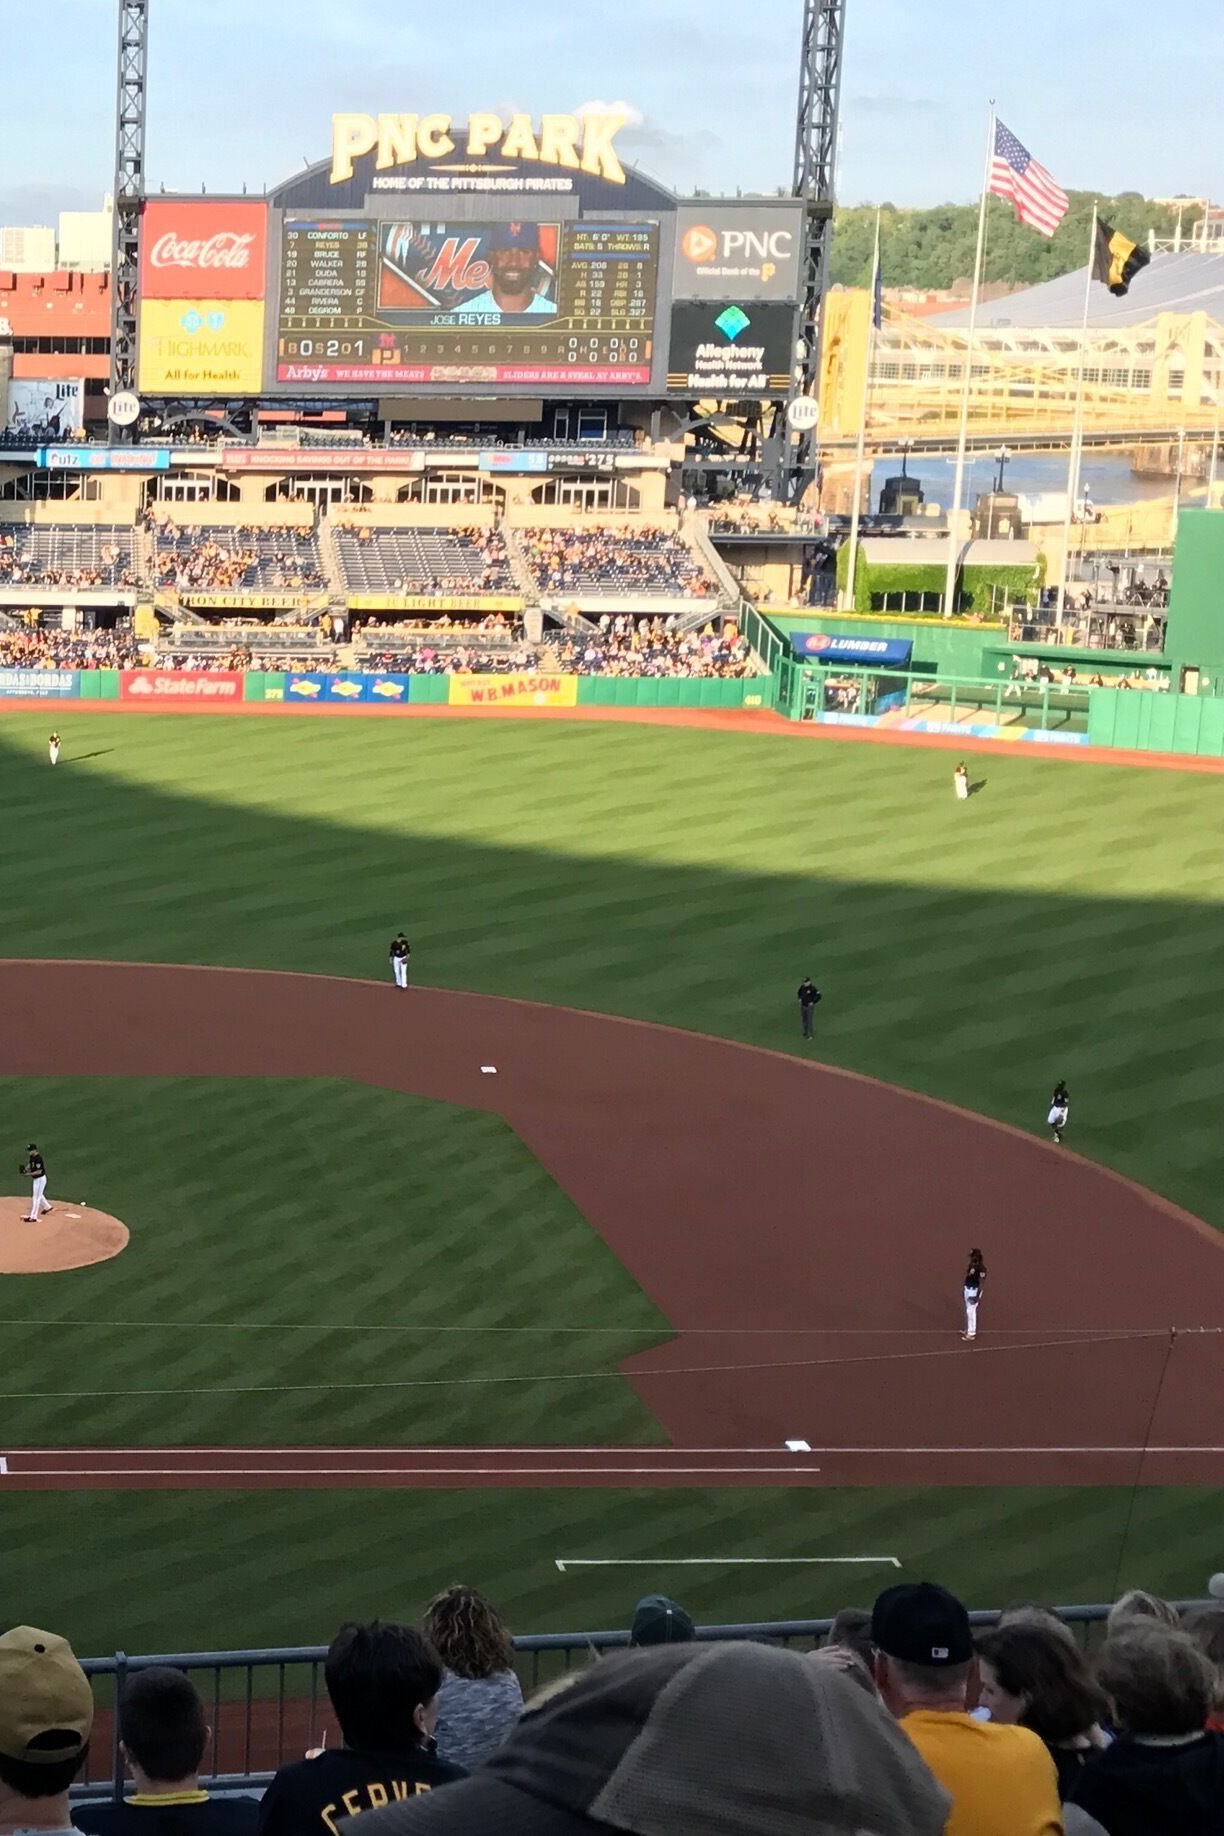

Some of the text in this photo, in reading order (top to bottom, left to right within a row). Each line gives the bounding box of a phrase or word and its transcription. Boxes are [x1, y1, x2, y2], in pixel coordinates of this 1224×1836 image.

[329, 113, 627, 185] PNC PARK
[373, 177, 573, 191] HOME OF THE PITTSBURGH PIRATES
[151, 232, 256, 268] Coca-Cola
[721, 230, 792, 258] PNC
[430, 313, 501, 325] JOSE REYES
[327, 340, 339, 356] 2
[354, 340, 363, 356] 1
[569, 338, 638, 348] 0 0 0 0
[568, 352, 637, 362] 0 0 0 0
[695, 344, 765, 362] Allegheny
[695, 360, 763, 370] Health Network
[164, 370, 241, 380] All for Health
[286, 365, 328, 381] Arby's
[336, 370, 350, 378] WE
[688, 374, 728, 388] Health
[729, 374, 747, 389] for
[56, 384, 78, 400] Lite
[113, 400, 136, 415] Lite
[792, 405, 817, 420] Lite
[251, 454, 295, 464] KNOCKING
[297, 454, 332, 464] SAVINGS
[334, 454, 352, 464] OUT
[354, 454, 365, 464] OF
[367, 454, 384, 464] THE
[223, 596, 258, 606] CITY
[404, 598, 444, 608] LIGHT
[830, 640, 888, 651] LUMBER
